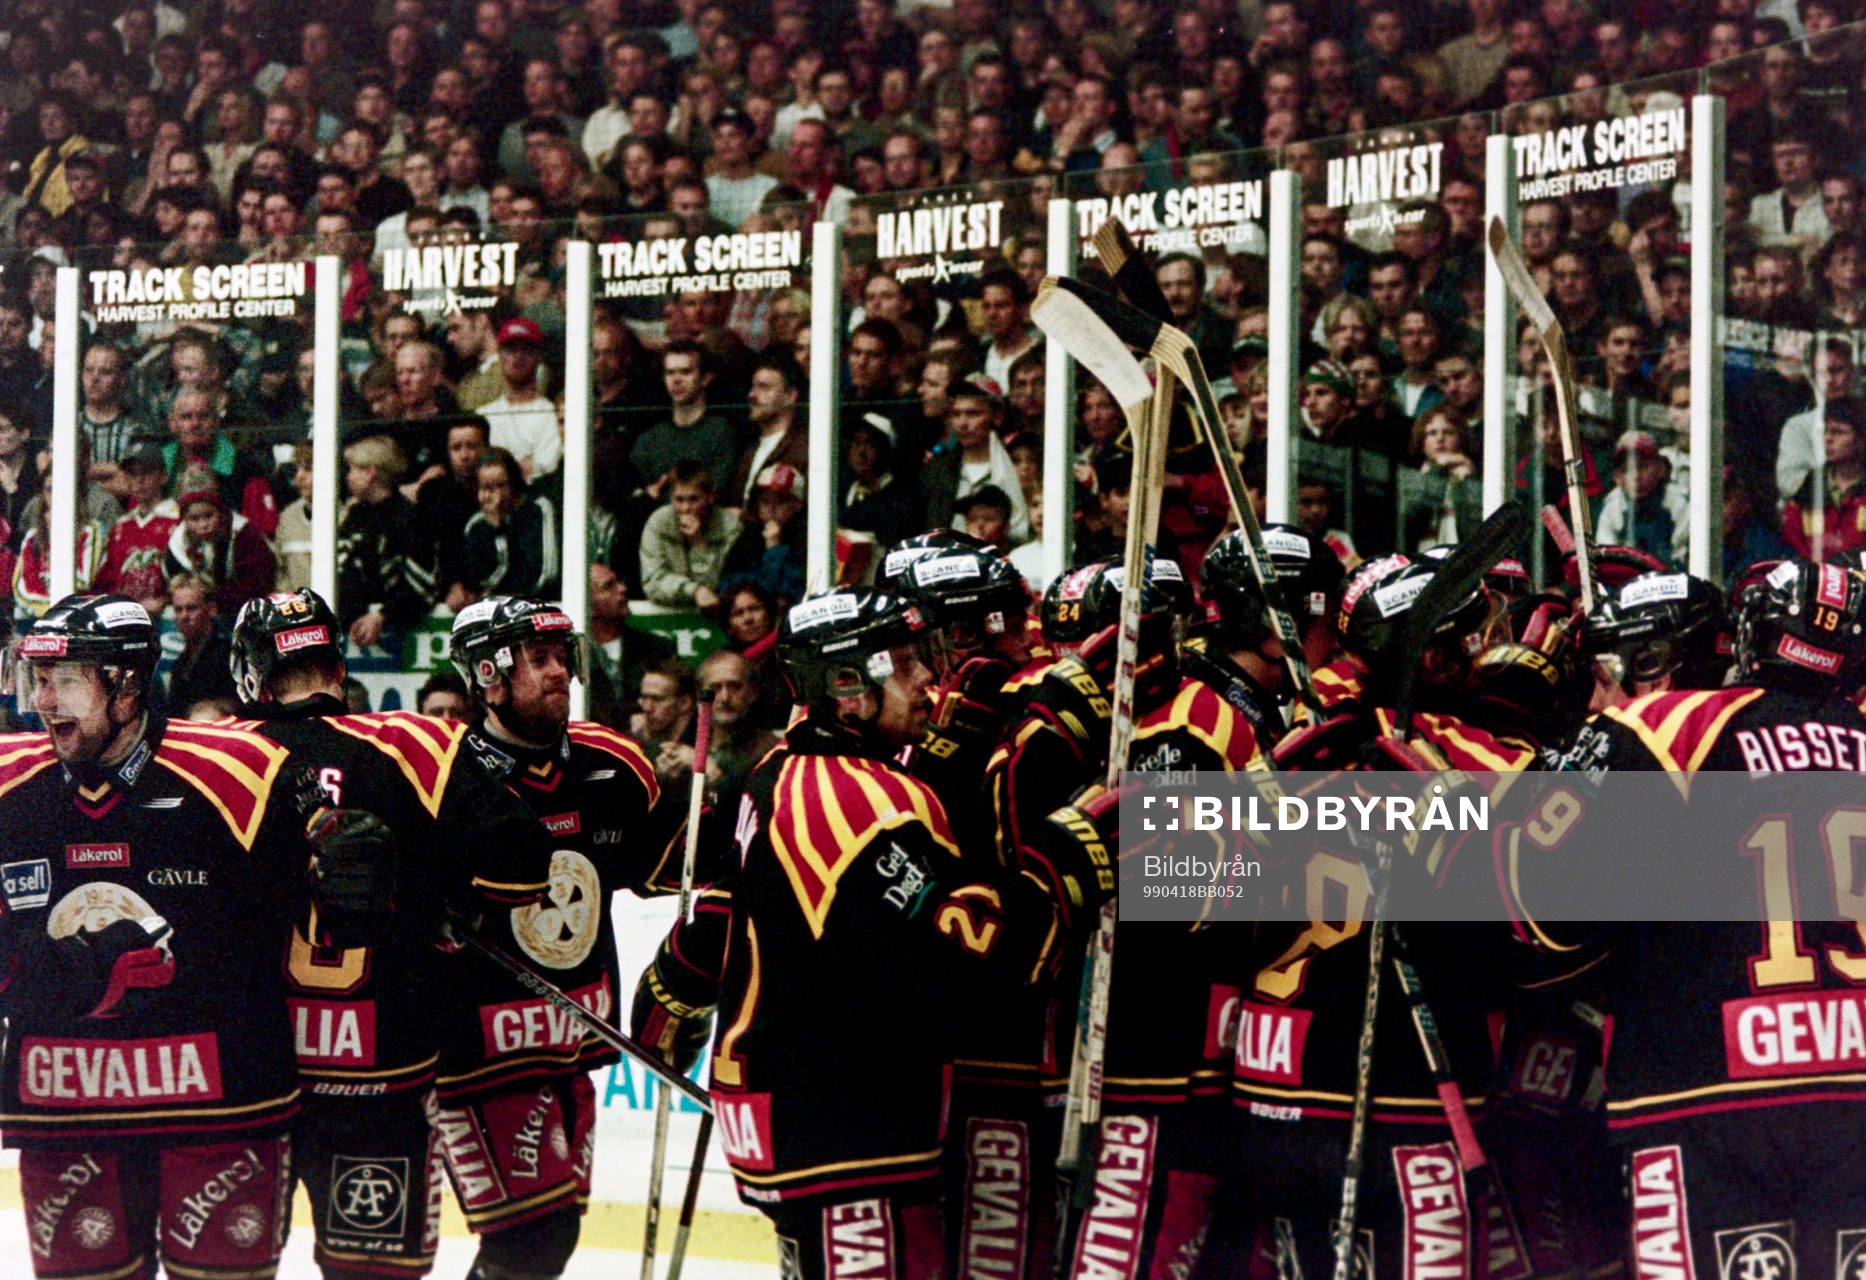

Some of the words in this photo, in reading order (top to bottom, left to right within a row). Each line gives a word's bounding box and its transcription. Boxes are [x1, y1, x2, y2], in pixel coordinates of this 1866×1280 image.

[1513, 125, 1587, 177] TRACK
[1594, 107, 1685, 164] SCREEN
[1327, 142, 1444, 208] HARVEST
[1519, 175, 1574, 201] HARVEST
[1574, 166, 1625, 192] PROFILE
[1627, 159, 1677, 182] CENTER
[877, 201, 1004, 258] HARVEST
[1076, 192, 1158, 237] TRACK
[1164, 180, 1262, 228] SCREEN
[598, 238, 687, 278] TRACK
[695, 231, 801, 272] SCREEN
[1144, 229, 1197, 252] PROFILE
[1200, 224, 1251, 247] CENTER
[89, 267, 184, 304] TRACK
[192, 262, 306, 298] SCREEN
[383, 243, 519, 291] HARVEST
[605, 277, 669, 297] HARVEST
[672, 273, 730, 293] PROFILE
[733, 270, 791, 289] CENTER
[97, 306, 163, 322] HARVEST
[168, 302, 230, 320] PROFILE
[233, 299, 295, 317] CENTER
[1057, 602, 1080, 623] 24
[1813, 606, 1839, 631] 19
[147, 868, 209, 886] GÄVLE
[27, 1042, 209, 1099] GEVALIA
[968, 1128, 1021, 1280] GEVALI
